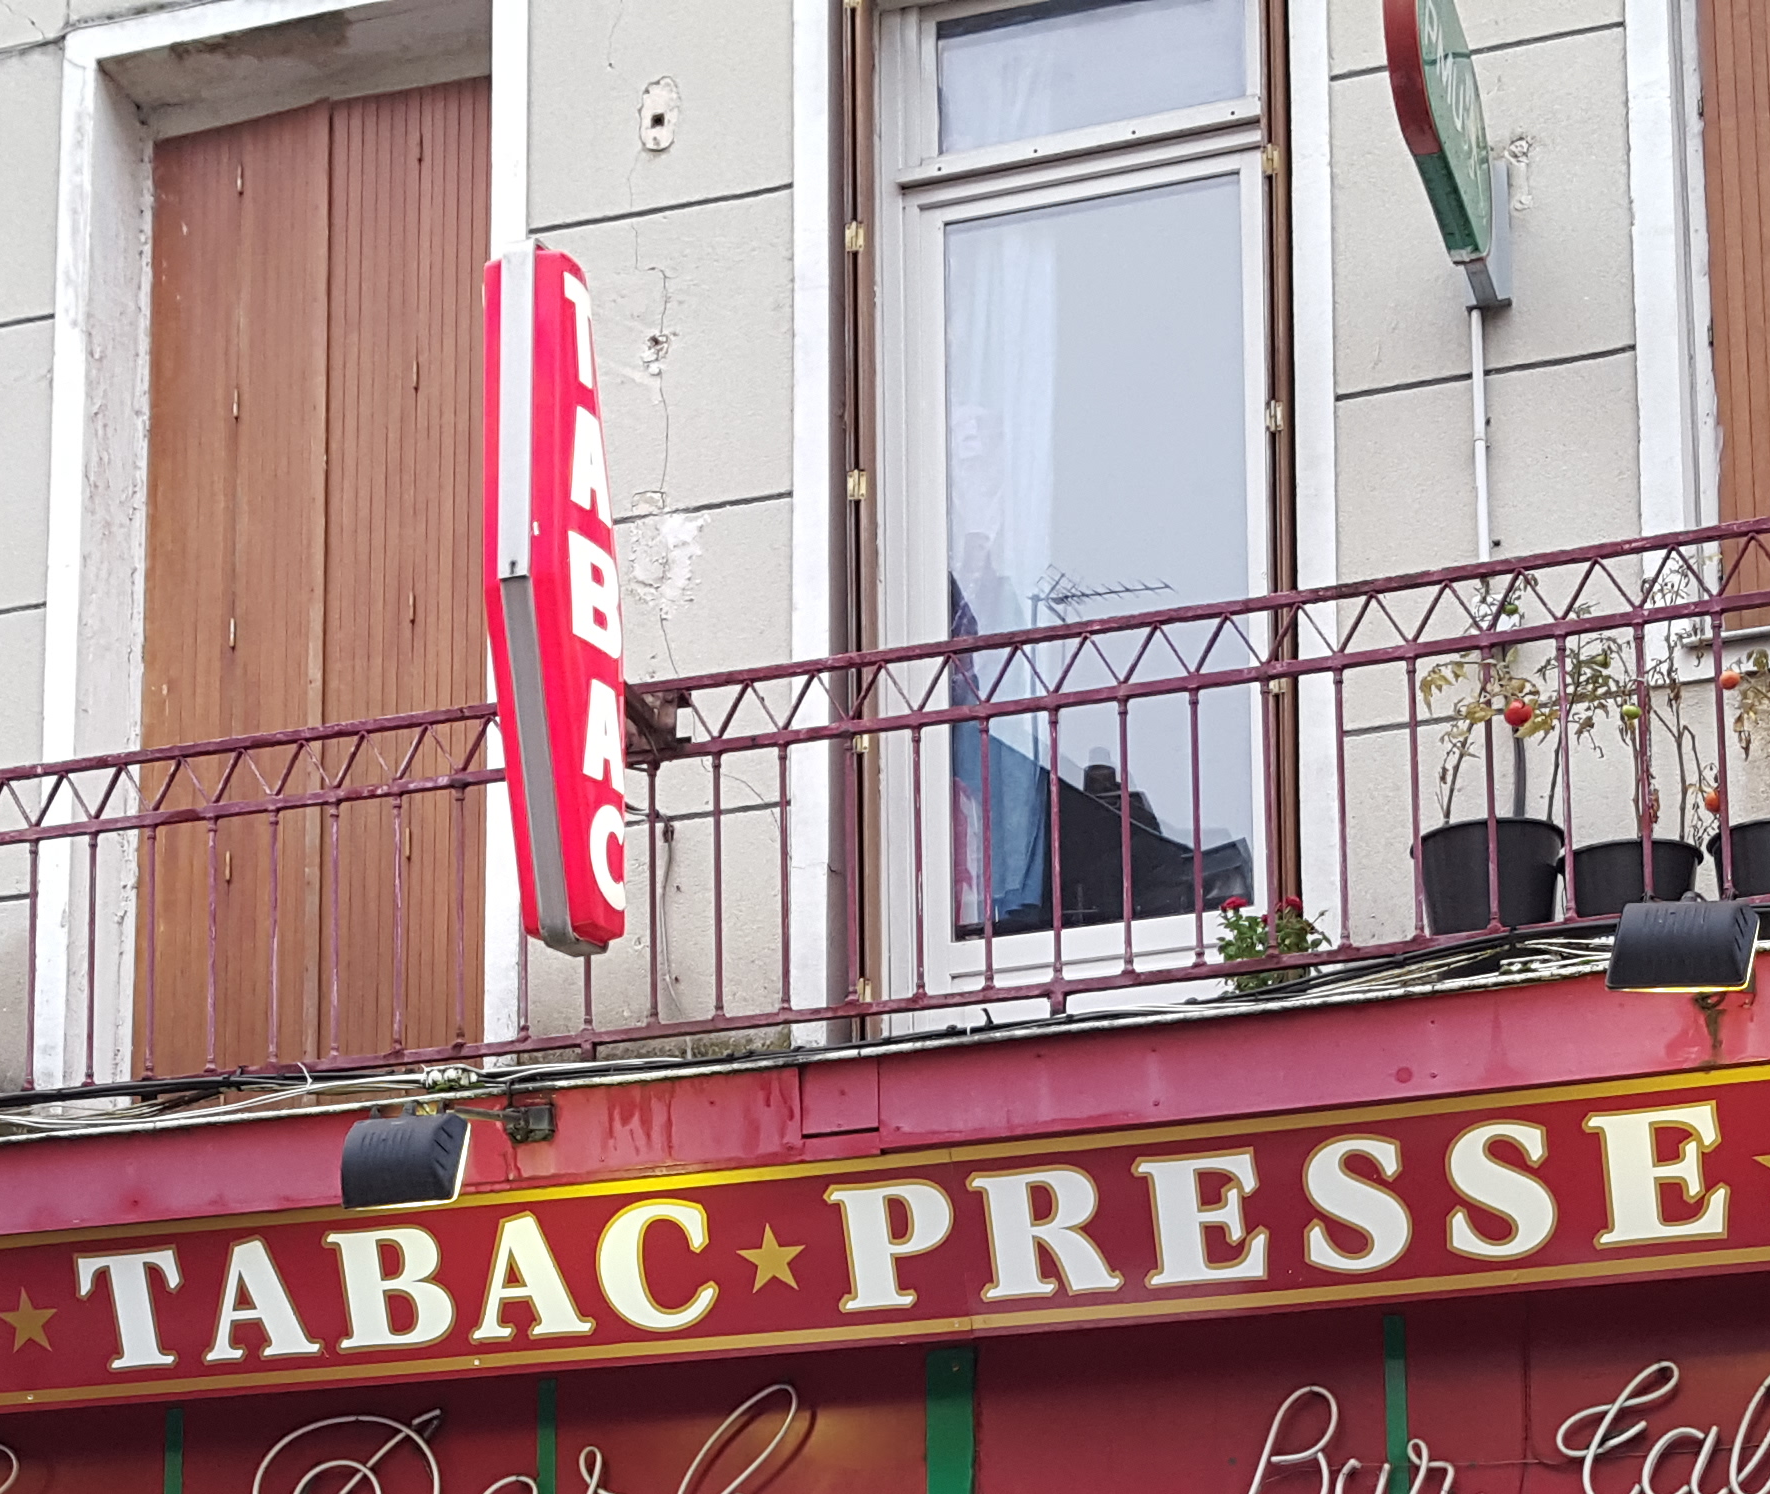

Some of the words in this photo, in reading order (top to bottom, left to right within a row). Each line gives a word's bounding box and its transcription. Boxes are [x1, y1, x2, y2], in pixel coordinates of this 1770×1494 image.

[564, 271, 627, 911] TABAC
[74, 1198, 720, 1373] TABAC
[824, 1100, 1731, 1314] PRESSE
